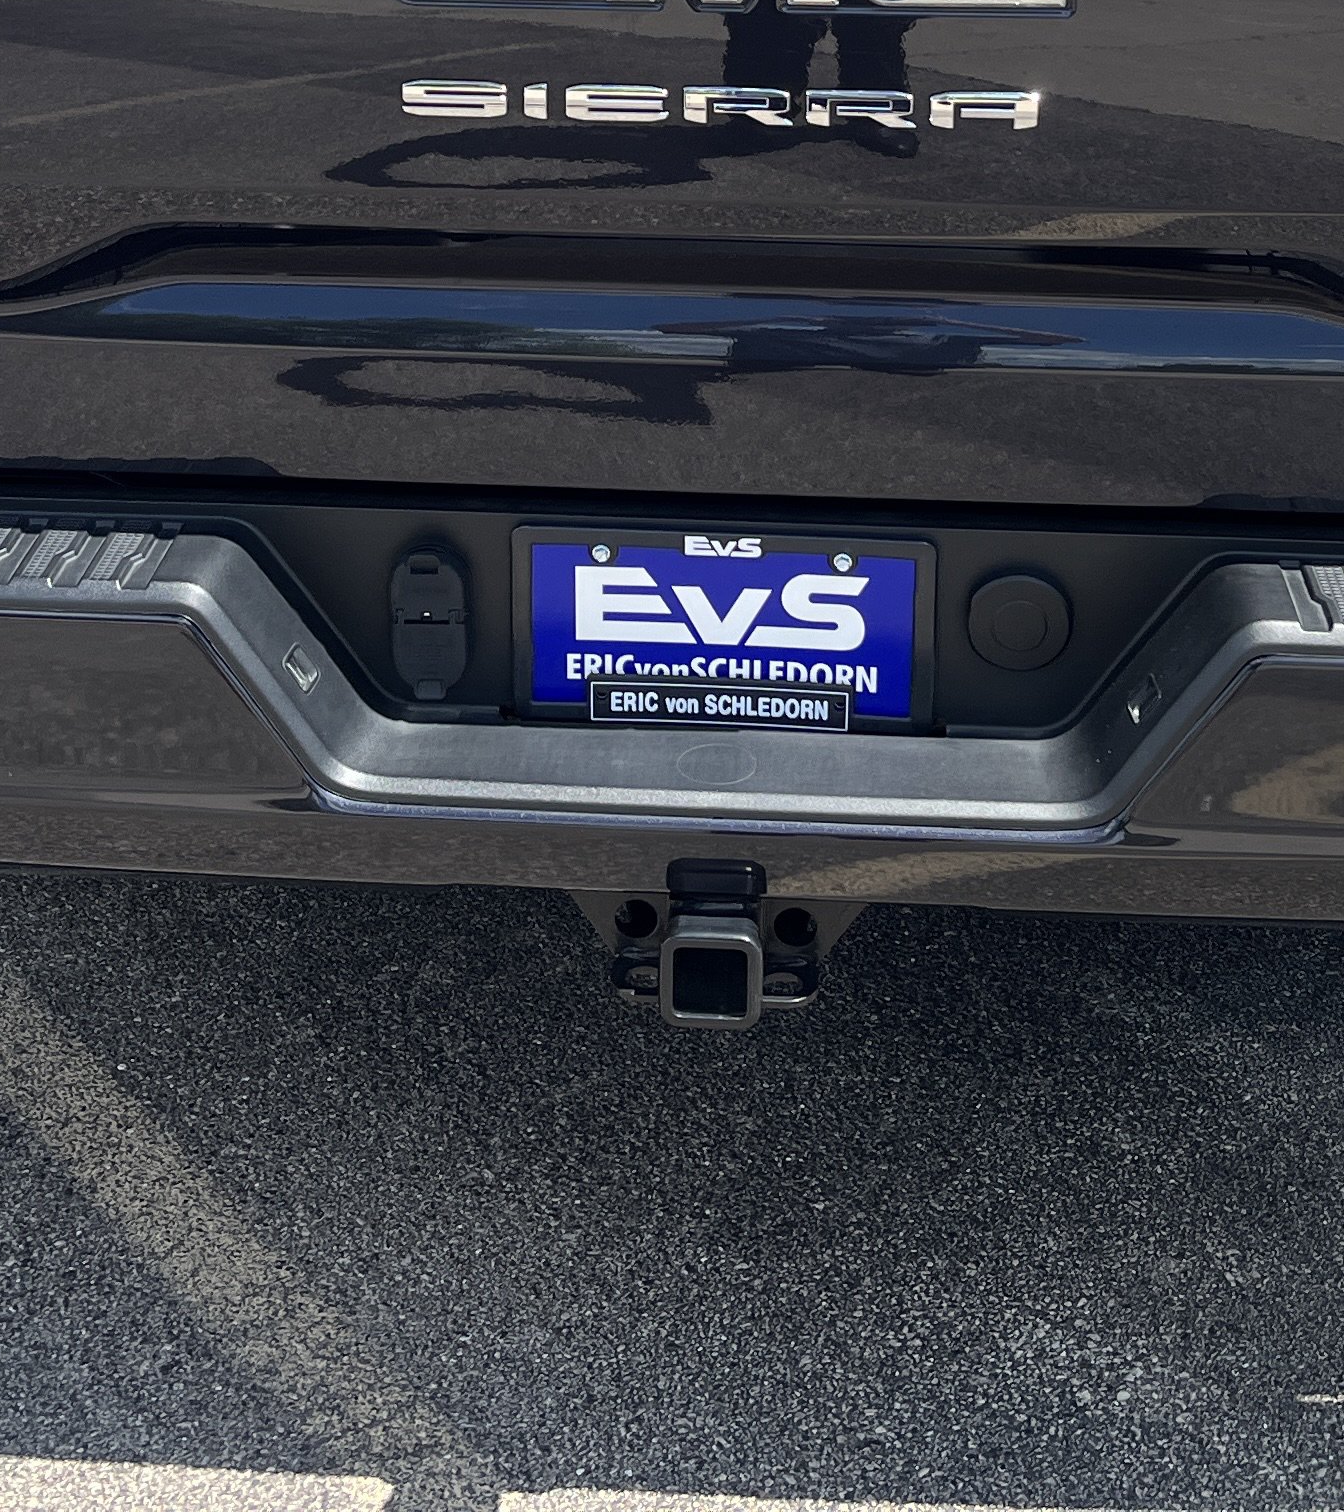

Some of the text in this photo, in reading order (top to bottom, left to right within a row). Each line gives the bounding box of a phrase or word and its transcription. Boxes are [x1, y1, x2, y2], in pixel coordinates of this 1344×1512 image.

[401, 79, 1041, 130] SIERRA
[610, 691, 829, 721] ERIC von SCHLEDORN
